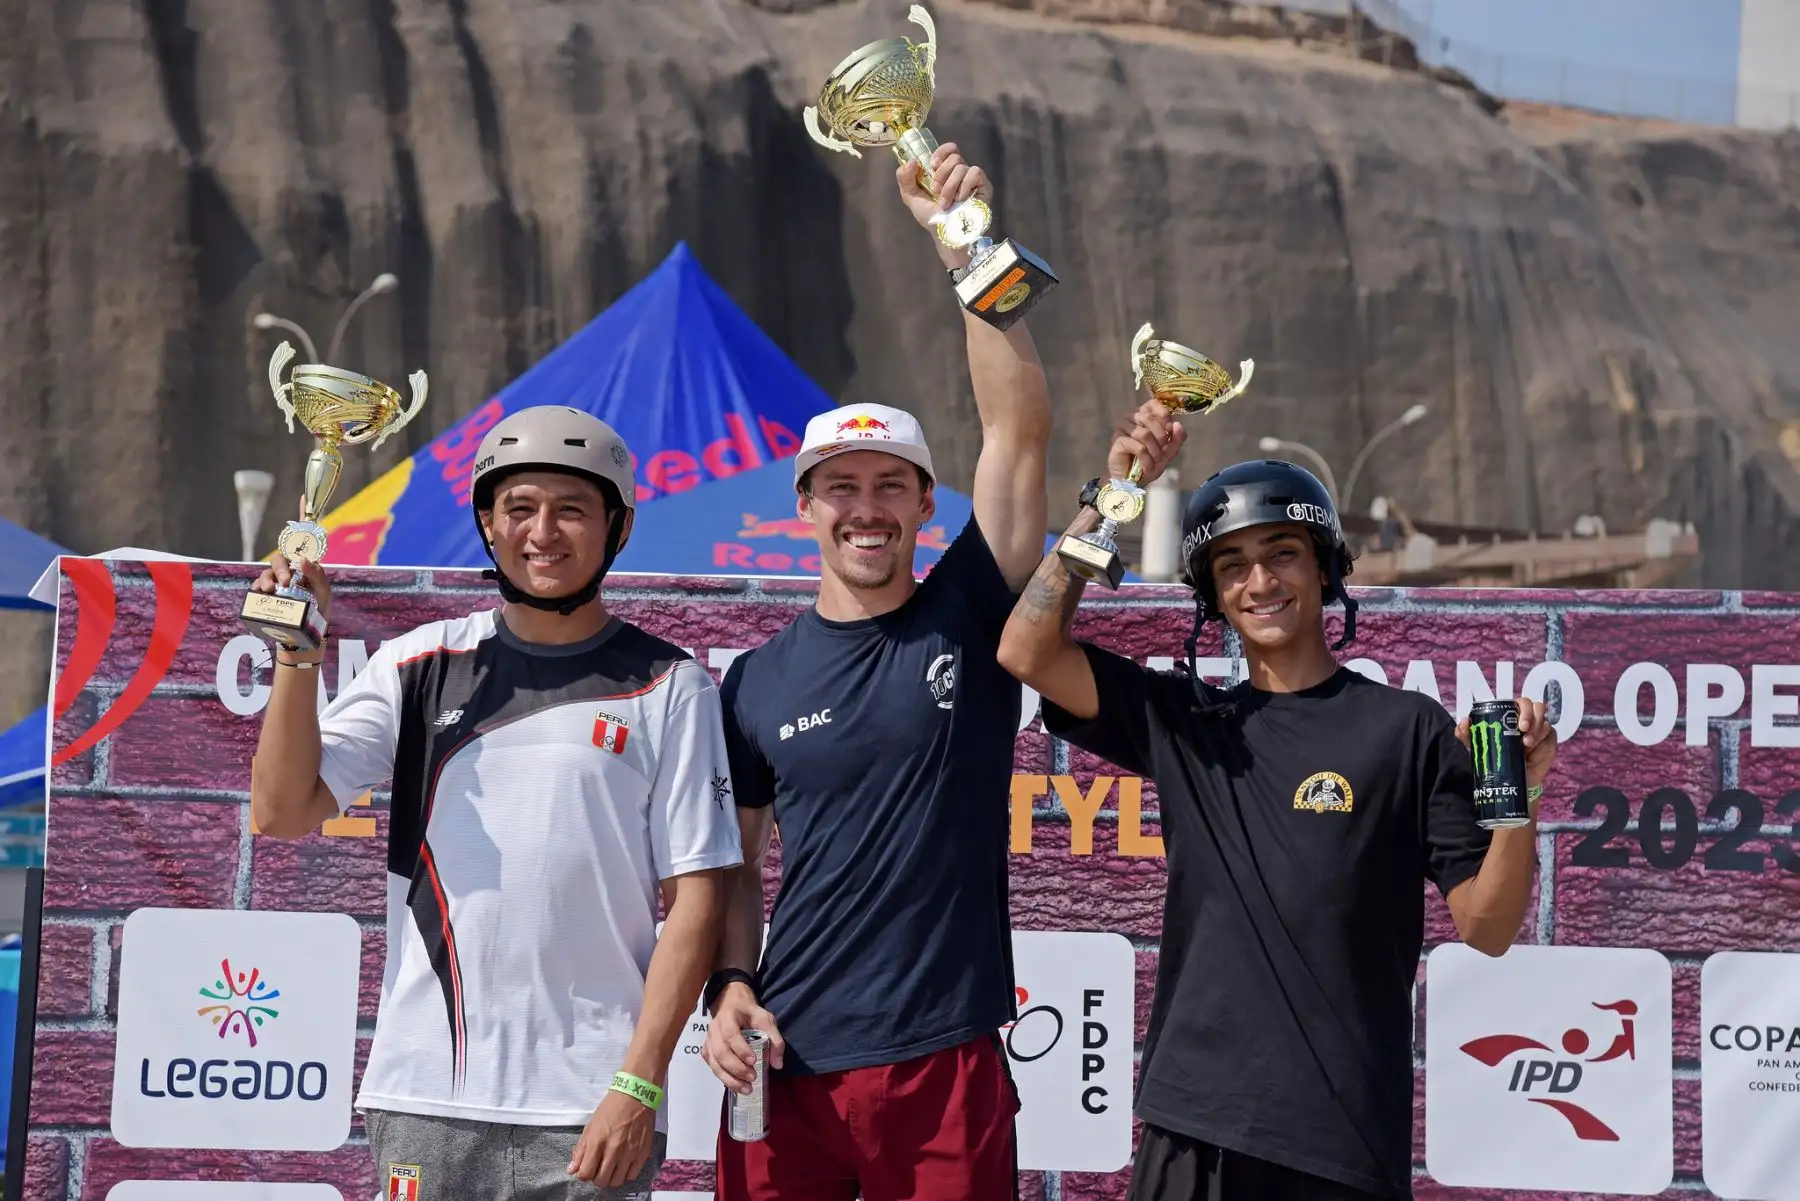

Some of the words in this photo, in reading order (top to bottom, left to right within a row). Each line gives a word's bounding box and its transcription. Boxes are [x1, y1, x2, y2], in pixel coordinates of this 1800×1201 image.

[598, 711, 628, 727] PERU
[797, 708, 832, 732] BAC
[1757, 1058, 1780, 1069] PAN
[1508, 1059, 1583, 1094] IPD
[631, 1081, 658, 1103] BMX
[392, 1167, 417, 1178] PERU
